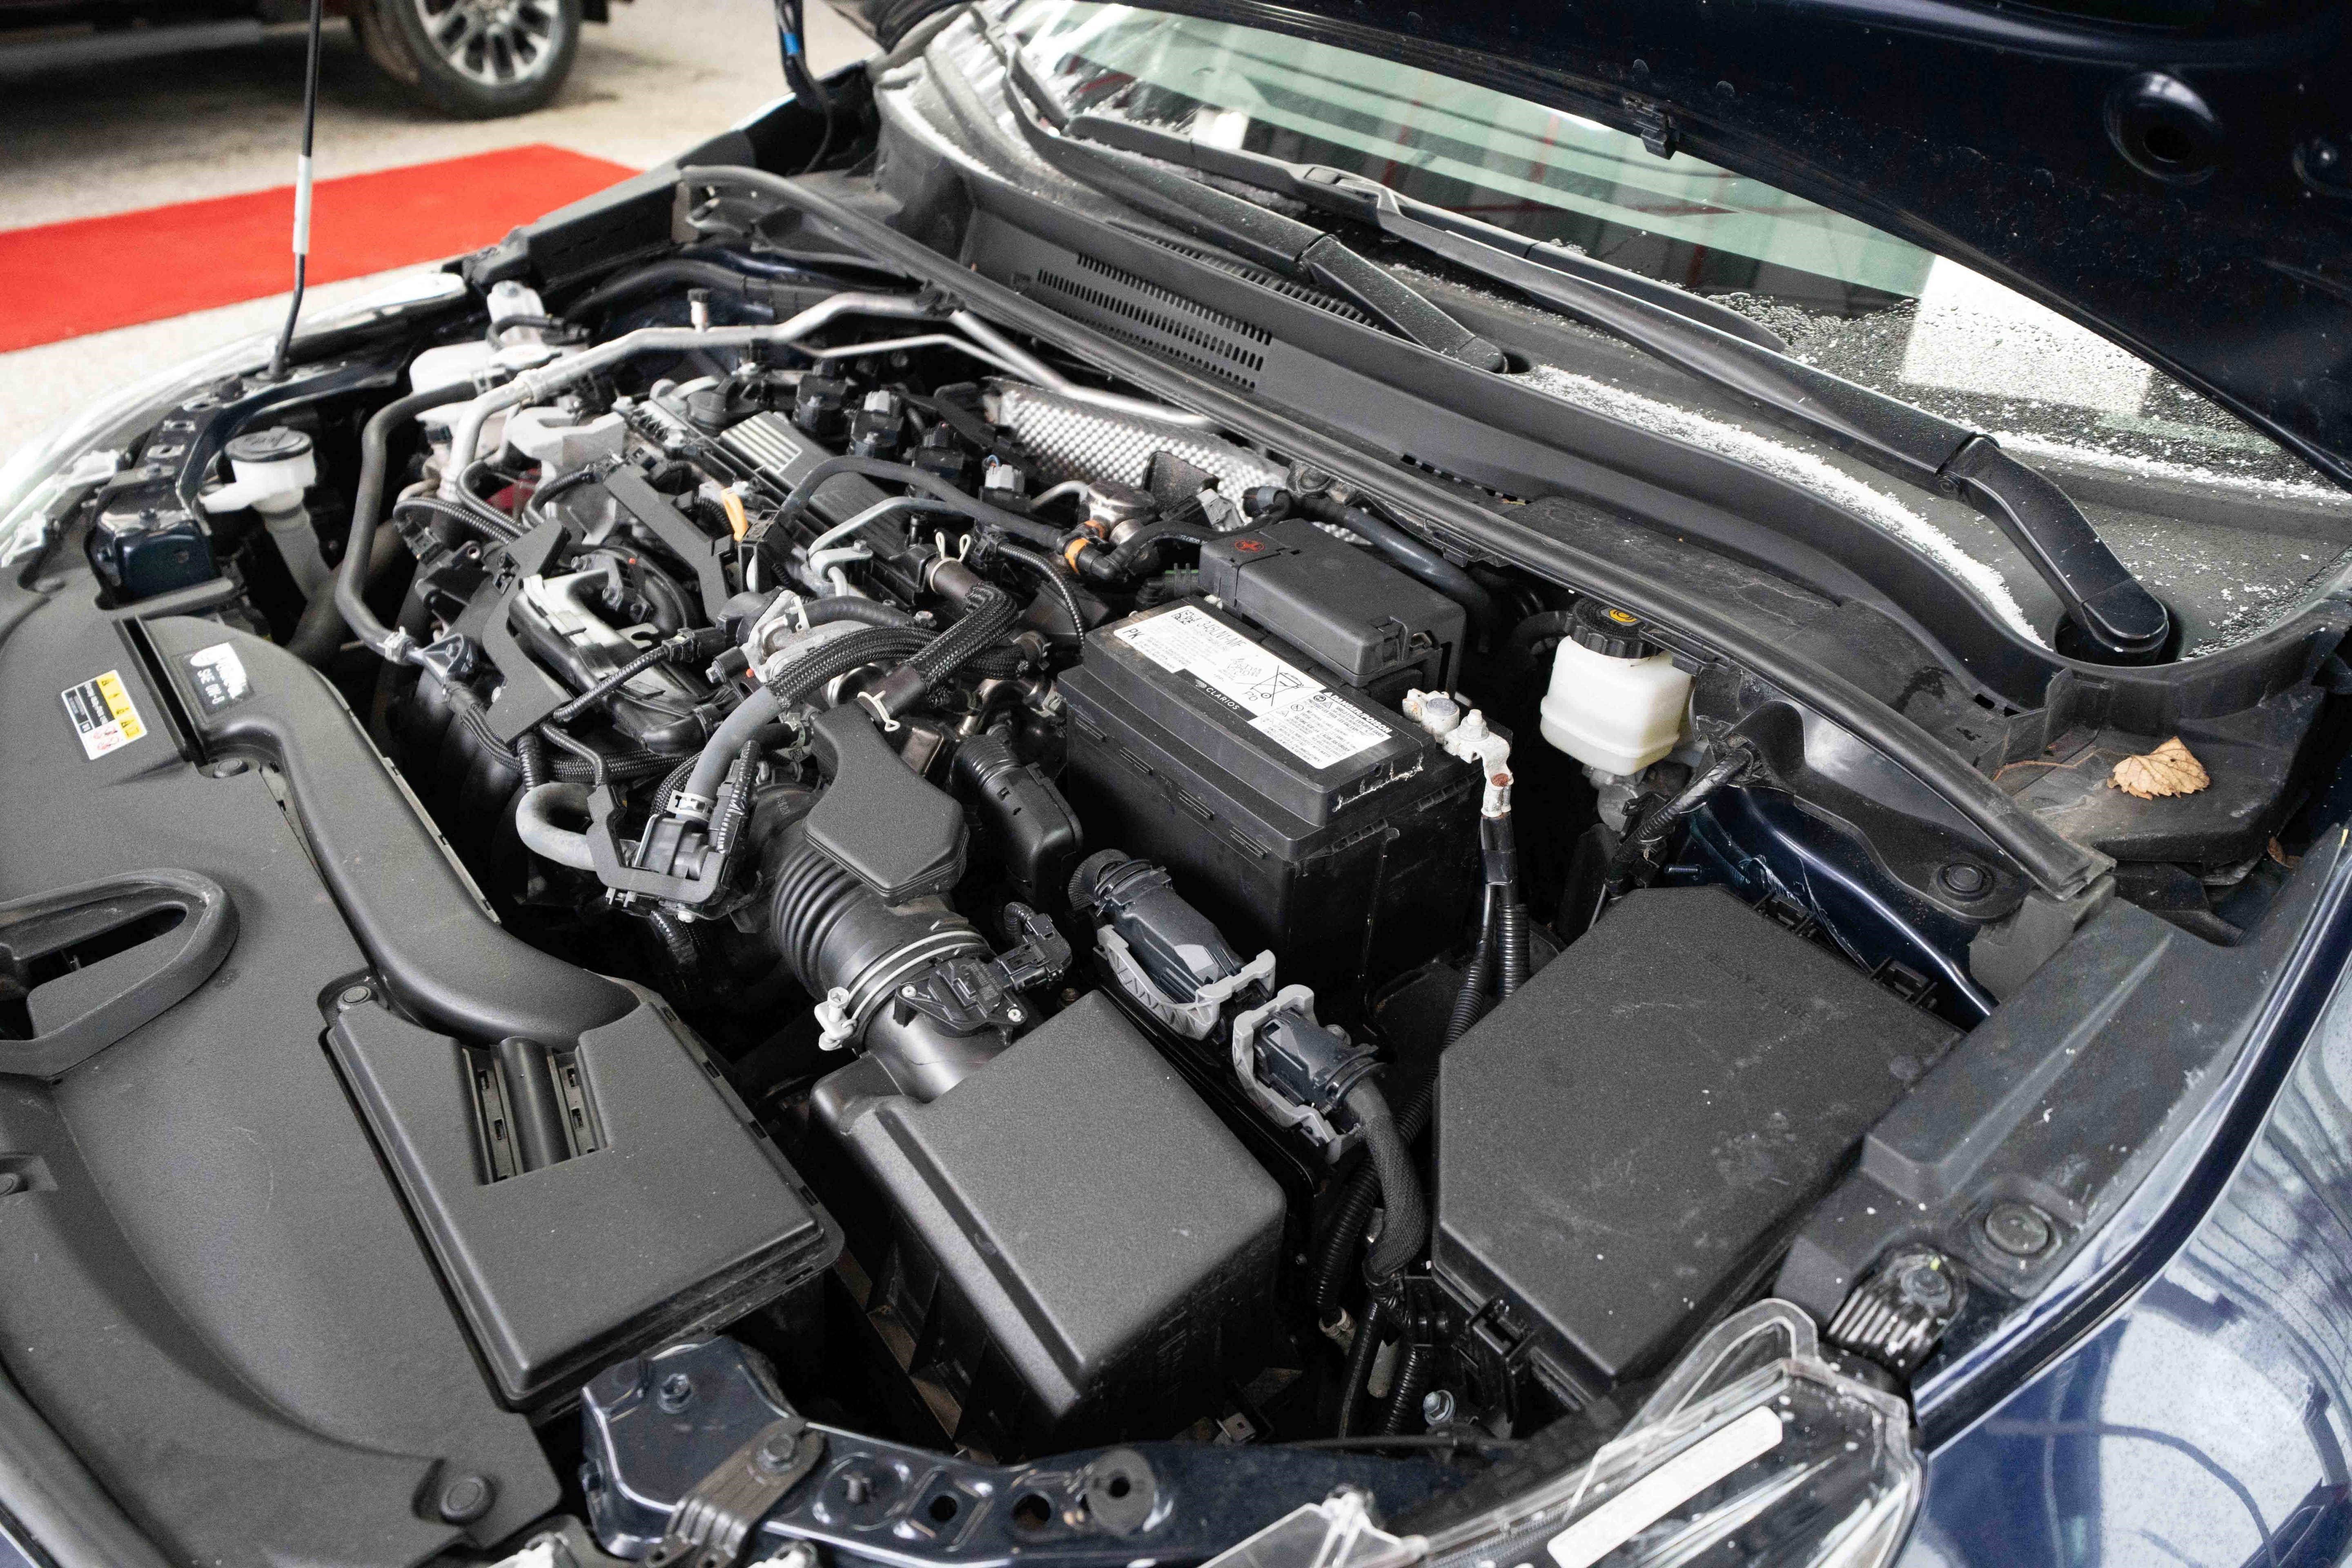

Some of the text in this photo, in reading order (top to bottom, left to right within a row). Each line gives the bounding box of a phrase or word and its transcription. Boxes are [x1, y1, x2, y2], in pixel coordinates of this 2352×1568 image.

[1122, 628, 1145, 640] PK
[1205, 688, 1241, 710] CLARIOS
[1242, 691, 1258, 701] Pb
[1330, 695, 1392, 733] DANGER/POISON
